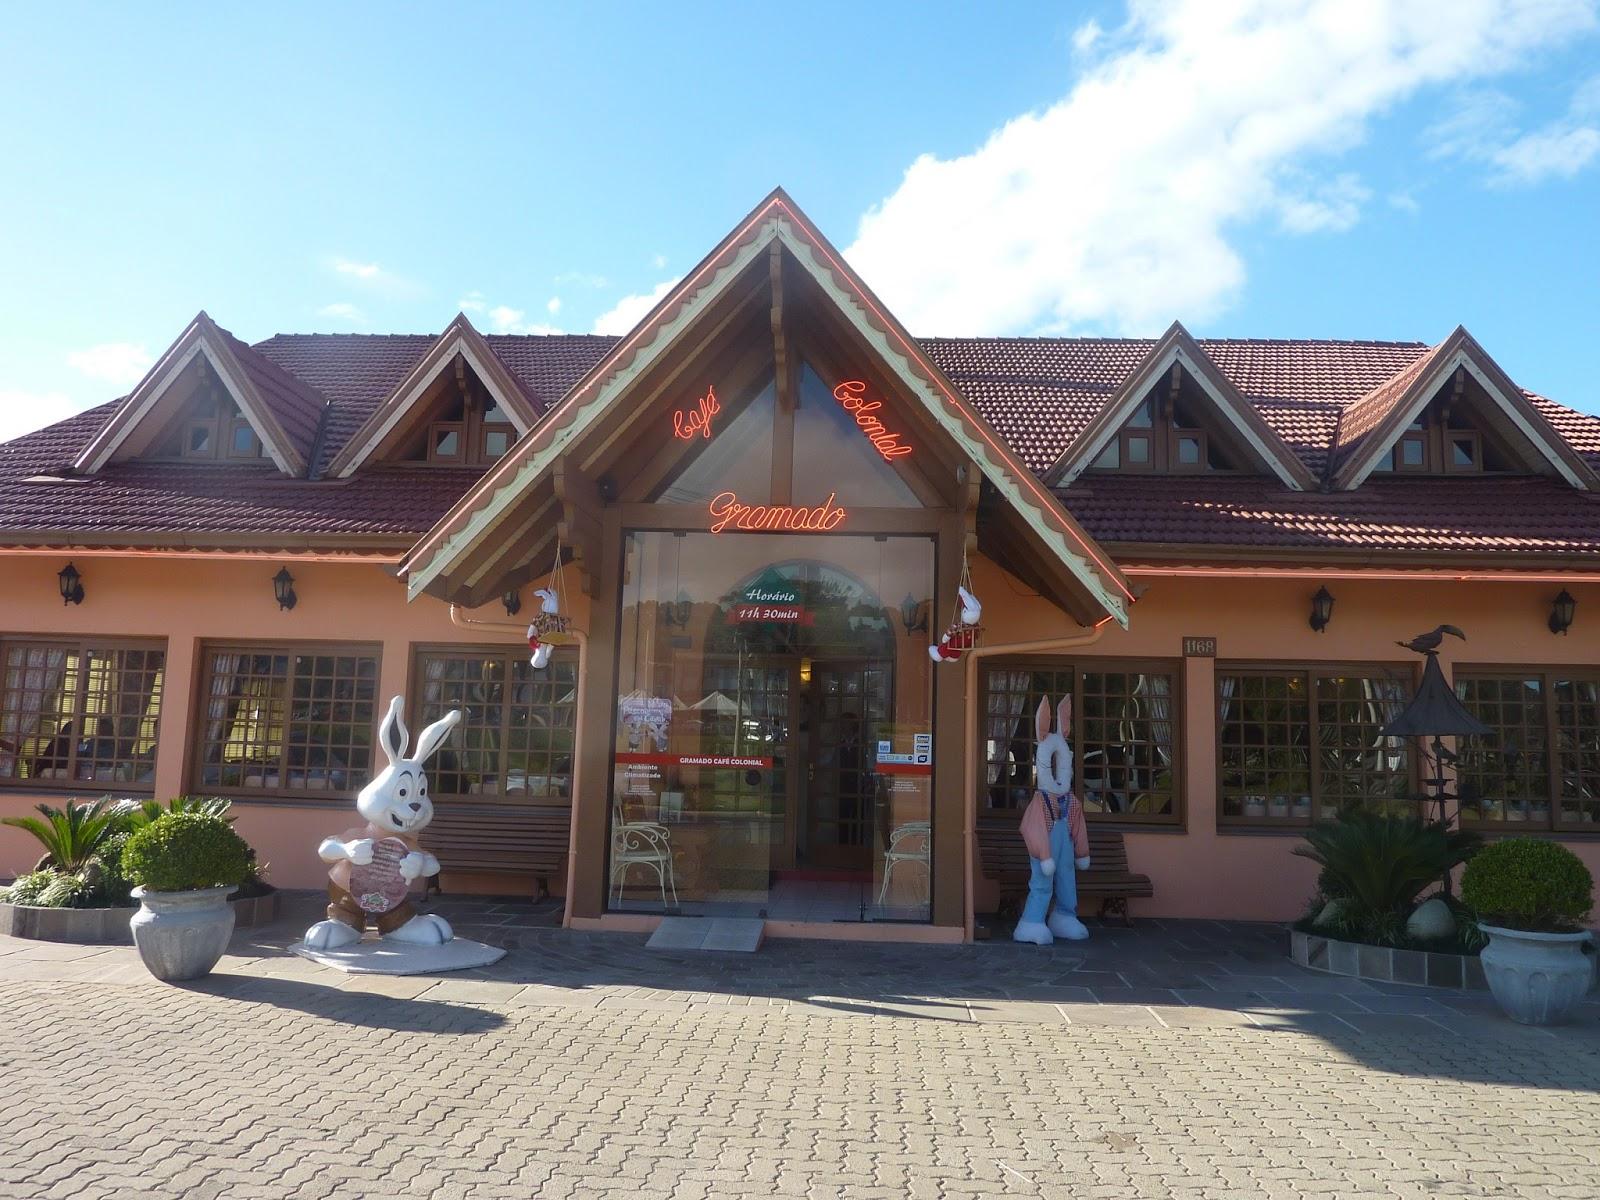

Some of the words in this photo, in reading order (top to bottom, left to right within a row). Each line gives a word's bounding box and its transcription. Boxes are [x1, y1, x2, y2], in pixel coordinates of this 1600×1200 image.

[674, 384, 721, 439] Café
[833, 380, 913, 461] Colonial
[709, 492, 846, 533] Gramado
[746, 588, 795, 602] Horário
[739, 606, 760, 619] 11h
[762, 609, 799, 619] 30min
[1185, 640, 1214, 654] 1168
[679, 757, 713, 765] GRAMADO
